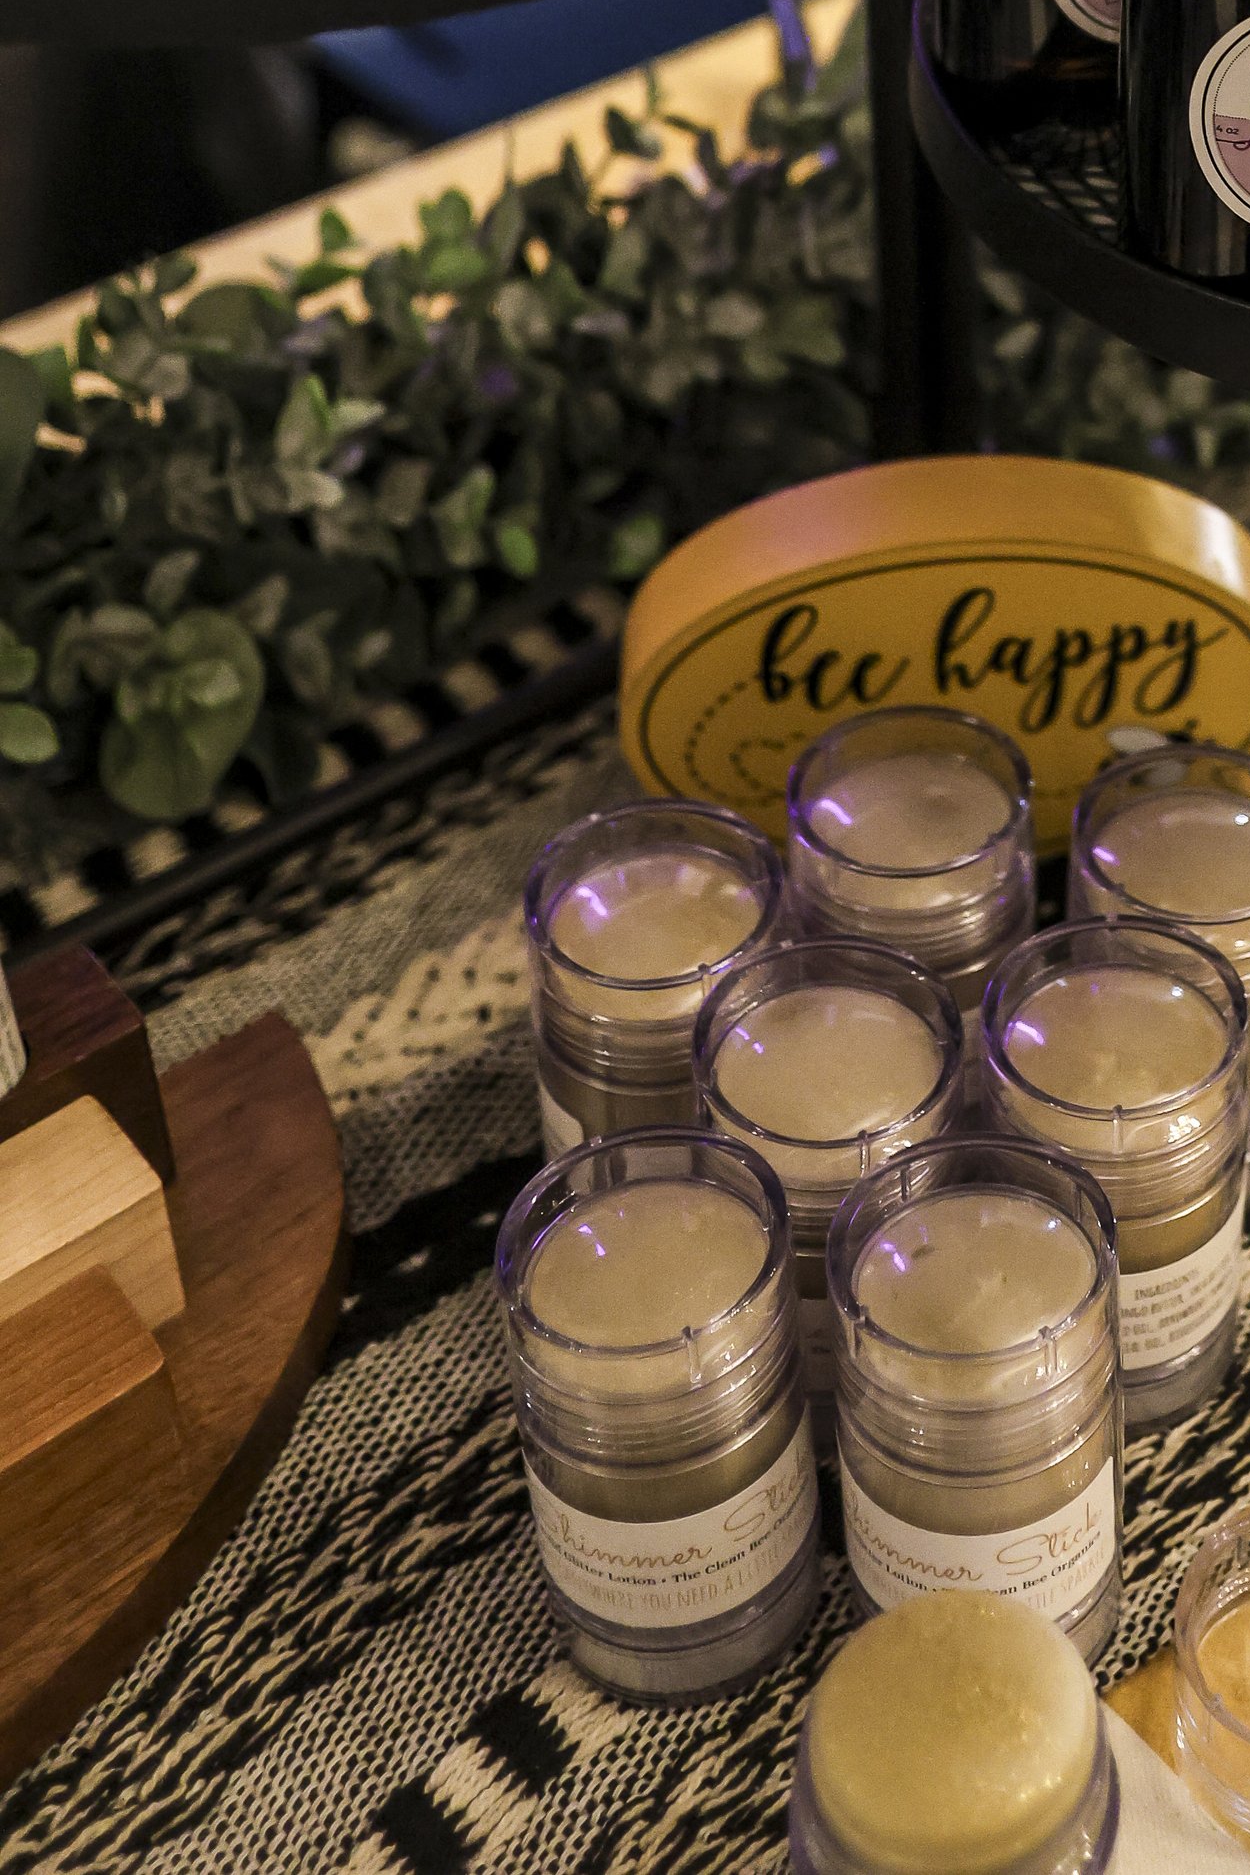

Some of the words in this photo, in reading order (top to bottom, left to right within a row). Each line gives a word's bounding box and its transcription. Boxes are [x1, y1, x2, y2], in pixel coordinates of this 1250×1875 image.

[757, 603, 911, 711] bee
[932, 585, 1232, 734] happy
[608, 1572, 657, 1586] Lotion
[672, 1571, 701, 1583] The
[705, 1550, 745, 1575] Clean
[886, 1563, 928, 1592] Lotion
[1022, 1574, 1048, 1590] Bee
